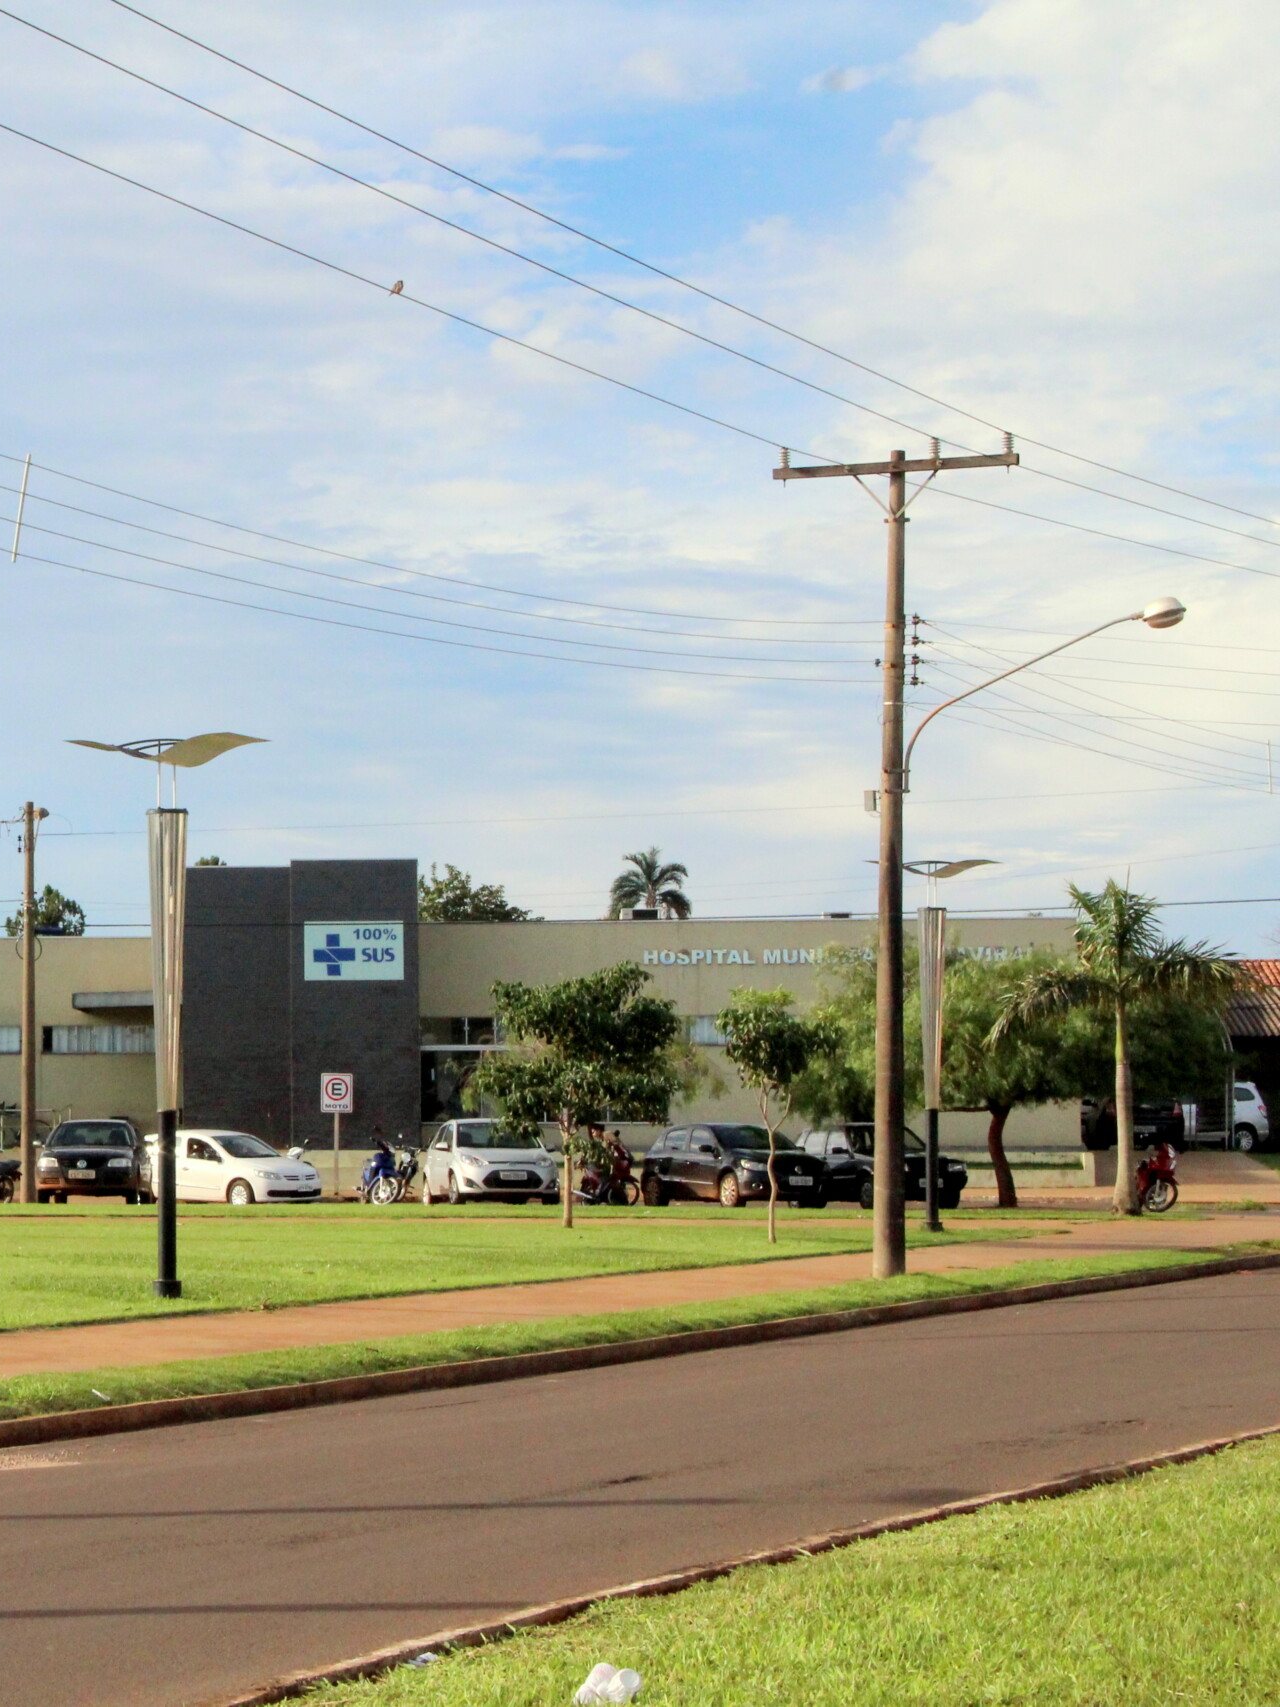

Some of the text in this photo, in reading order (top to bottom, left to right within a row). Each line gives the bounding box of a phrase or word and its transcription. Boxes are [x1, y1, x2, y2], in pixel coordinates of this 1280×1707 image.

[353, 928, 397, 941] 100%
[361, 947, 395, 963] SUS
[643, 949, 756, 965] HOSPITAL
[331, 1082, 342, 1096] E
